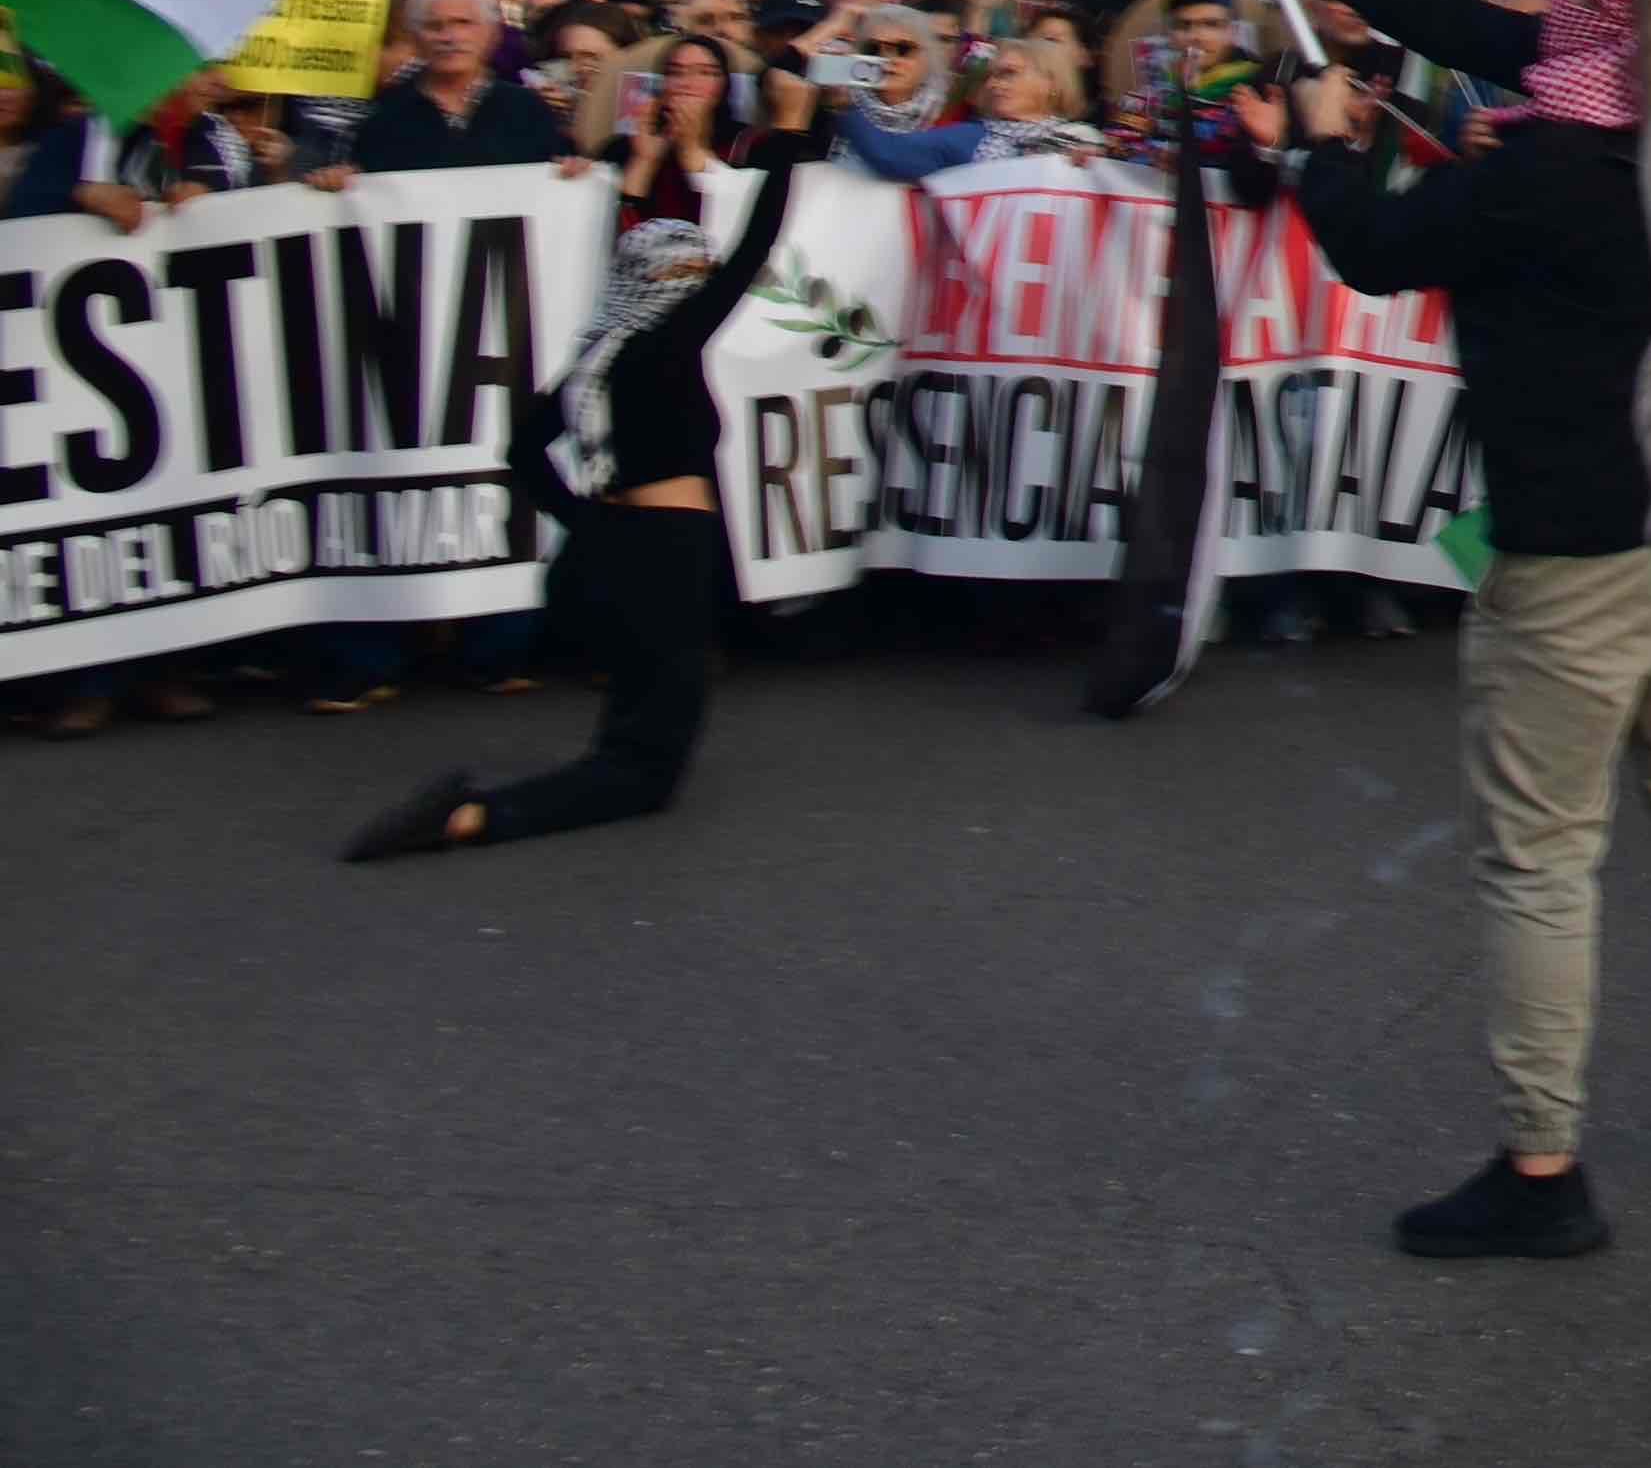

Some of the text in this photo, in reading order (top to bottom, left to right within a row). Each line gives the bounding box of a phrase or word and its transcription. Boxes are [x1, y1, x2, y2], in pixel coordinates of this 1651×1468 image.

[62, 522, 194, 612] DEL
[195, 486, 311, 588] RÍO
[313, 491, 377, 568] AL
[376, 482, 510, 566] MAR
